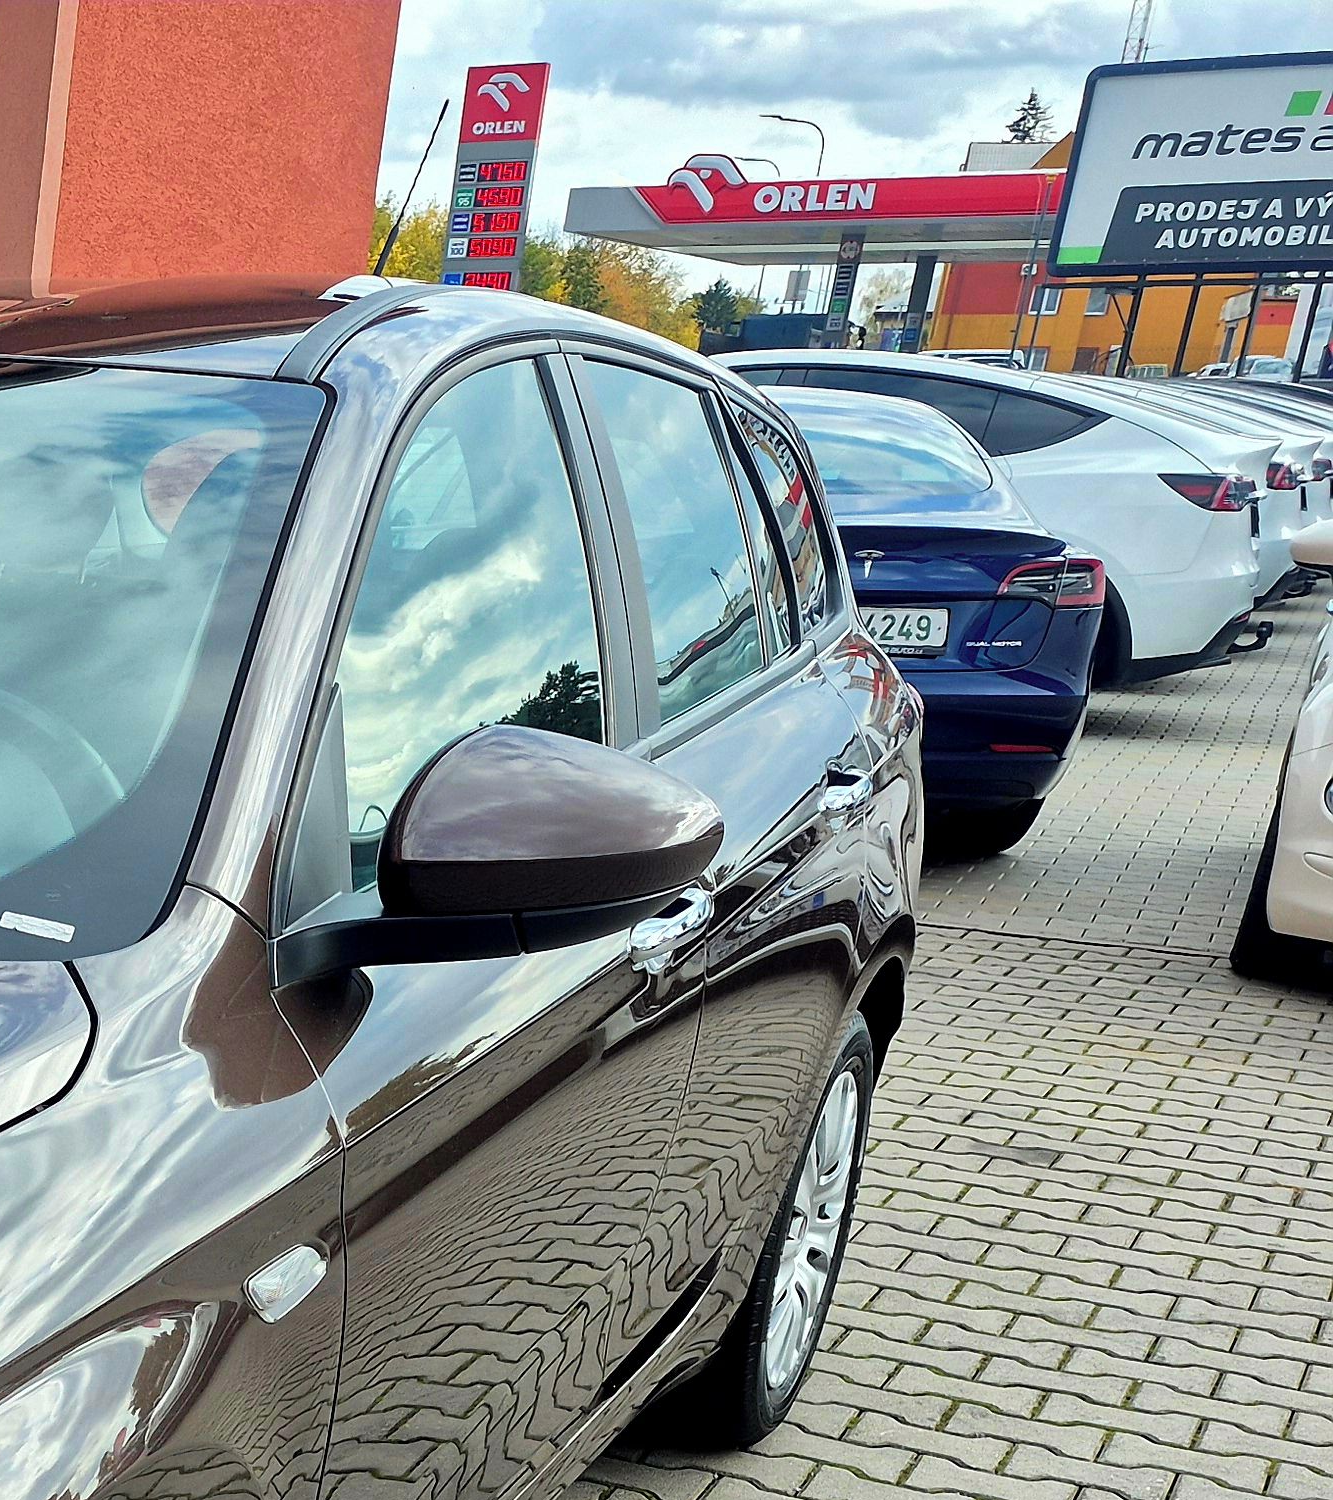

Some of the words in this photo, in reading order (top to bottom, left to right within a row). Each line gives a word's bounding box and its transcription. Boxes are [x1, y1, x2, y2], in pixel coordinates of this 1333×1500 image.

[472, 120, 526, 135] ORLEN
[1131, 124, 1306, 159] mates
[754, 183, 877, 213] ORLEN
[1135, 197, 1263, 223] PRODEJ
[1262, 202, 1282, 220] A
[1155, 224, 1333, 249] AUTOMOBIL
